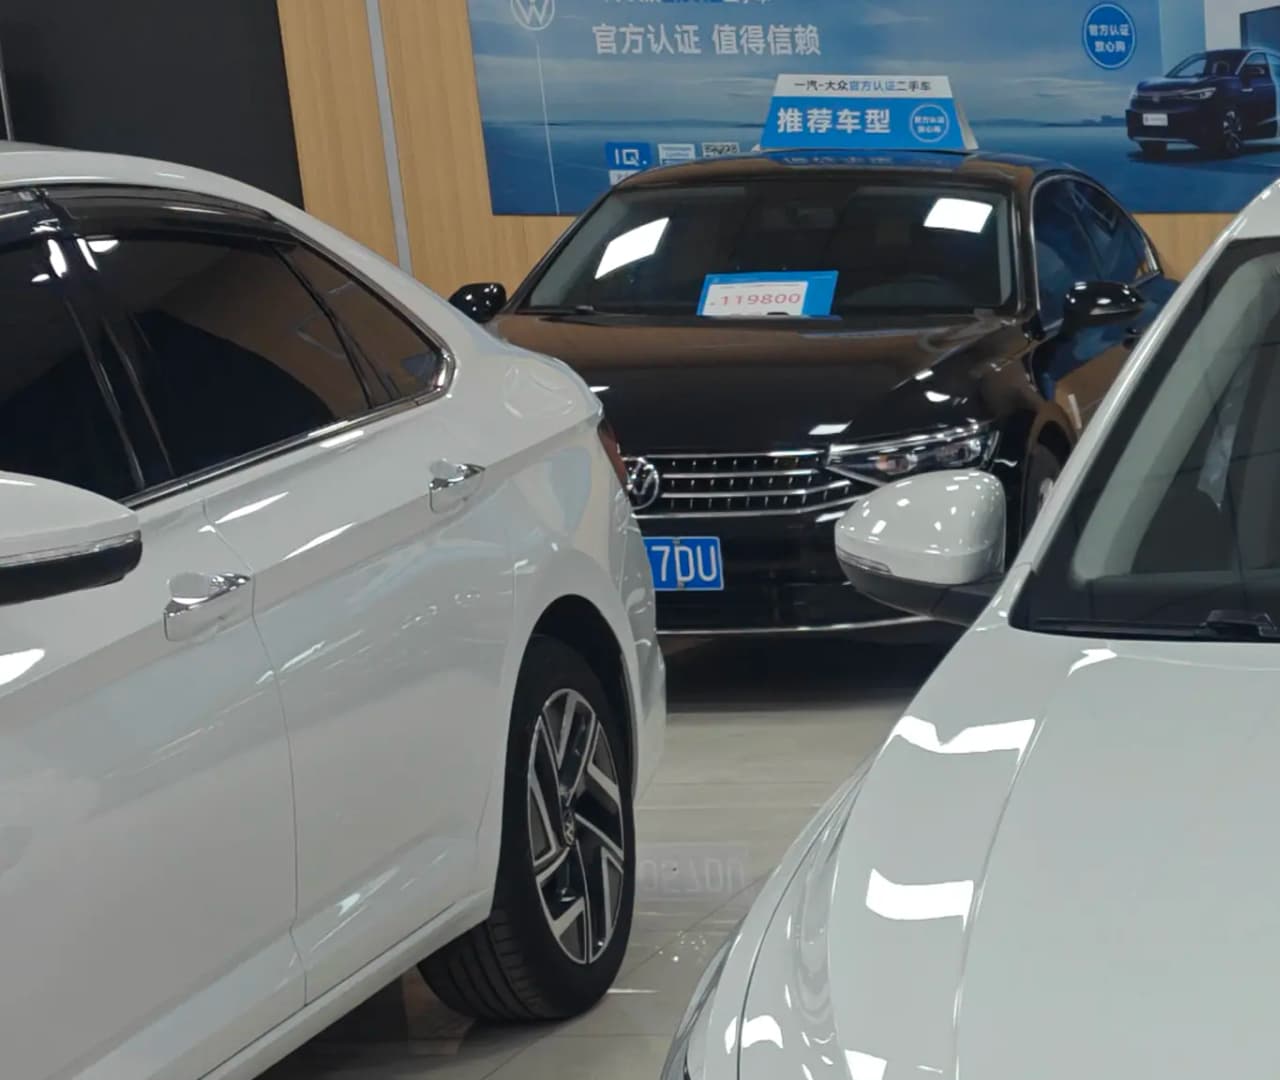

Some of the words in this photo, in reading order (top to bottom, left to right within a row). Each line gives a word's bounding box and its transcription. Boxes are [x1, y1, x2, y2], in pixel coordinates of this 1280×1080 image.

[593, 25, 700, 55] 官方认证
[712, 25, 821, 55] 值得信赖
[795, 80, 931, 91] 一汽-大众官方认证二手车
[777, 107, 891, 134] 推荐车型
